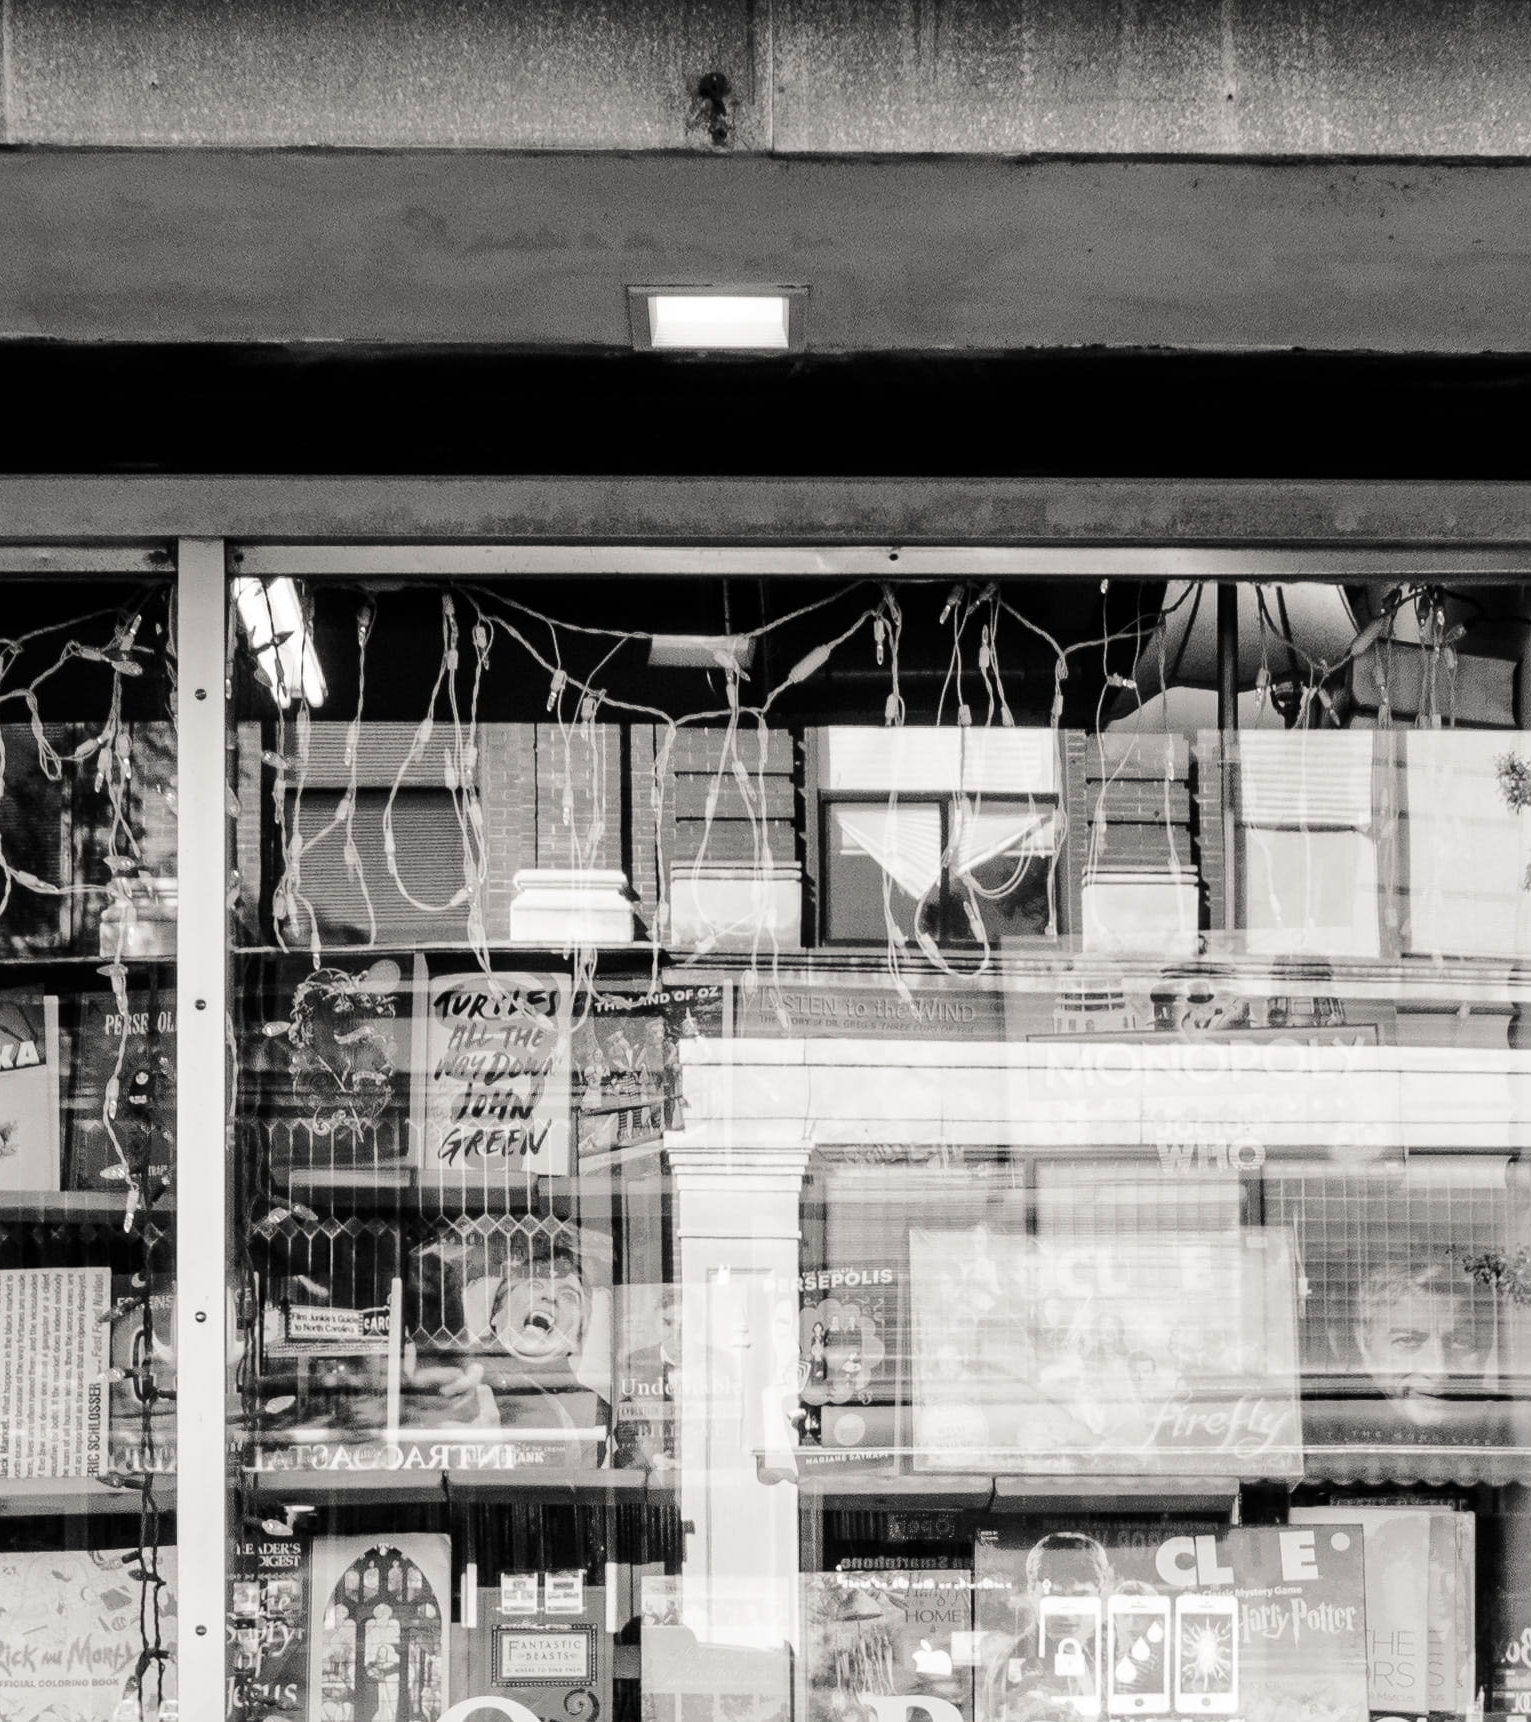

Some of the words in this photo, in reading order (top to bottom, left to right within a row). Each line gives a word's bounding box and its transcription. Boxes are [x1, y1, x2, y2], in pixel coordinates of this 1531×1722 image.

[455, 1090, 535, 1123] JOHN
[437, 1118, 551, 1168] GREEN
[763, 1268, 892, 1294] PERSEPOLIS
